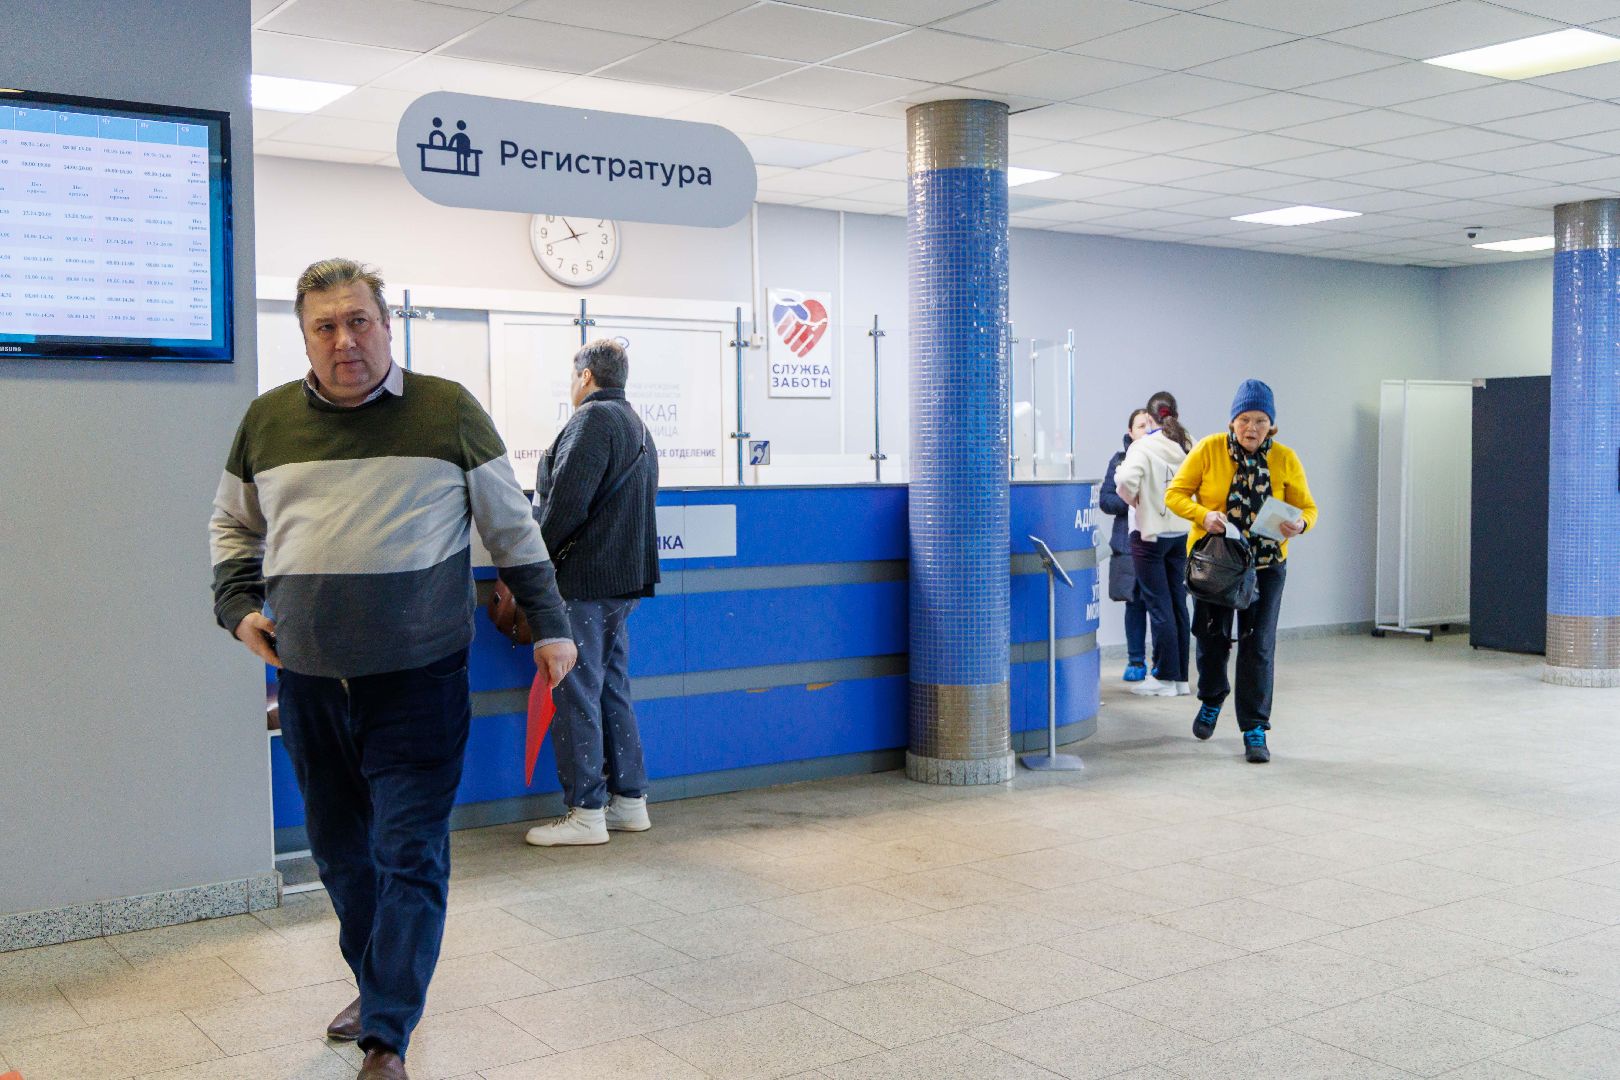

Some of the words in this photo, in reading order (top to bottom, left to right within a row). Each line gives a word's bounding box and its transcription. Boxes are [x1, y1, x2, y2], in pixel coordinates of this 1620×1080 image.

[500, 140, 712, 188] Регистратура
[540, 227, 548, 239] 9
[601, 233, 608, 245] 3
[546, 244, 553, 256] 8
[597, 249, 604, 260] 4
[556, 257, 564, 269] 7
[571, 263, 579, 275] 6
[585, 260, 593, 272] 5
[772, 363, 830, 375] СЛУЖБА
[772, 377, 831, 388] ЗАБОТЫ
[669, 448, 717, 459] ОТДЕЛЕНИЕ
